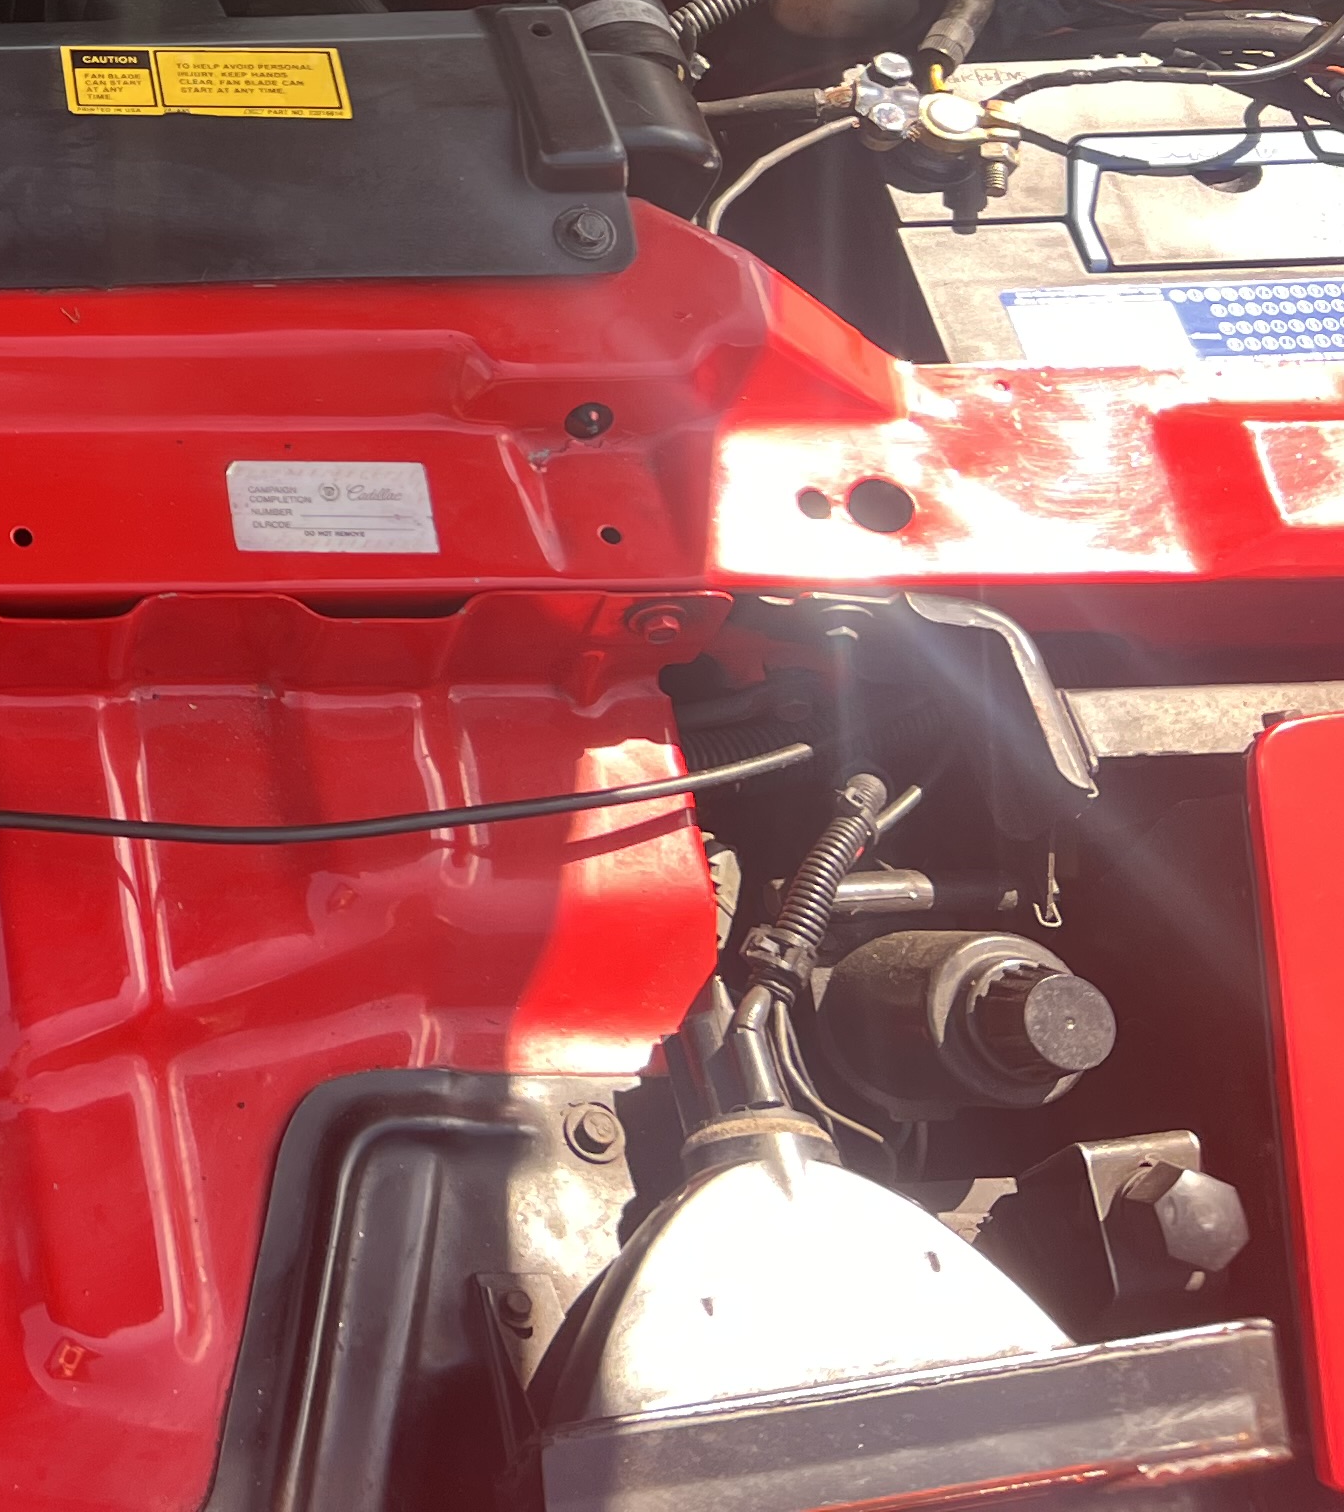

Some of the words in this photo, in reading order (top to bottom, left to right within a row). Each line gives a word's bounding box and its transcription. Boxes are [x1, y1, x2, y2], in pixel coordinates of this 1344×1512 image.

[82, 55, 138, 64] CAUTION
[247, 486, 297, 494] CAMPAIGN
[346, 484, 403, 501] Cadillac
[249, 495, 312, 504] COMPLETION
[251, 508, 293, 516] NUMBER
